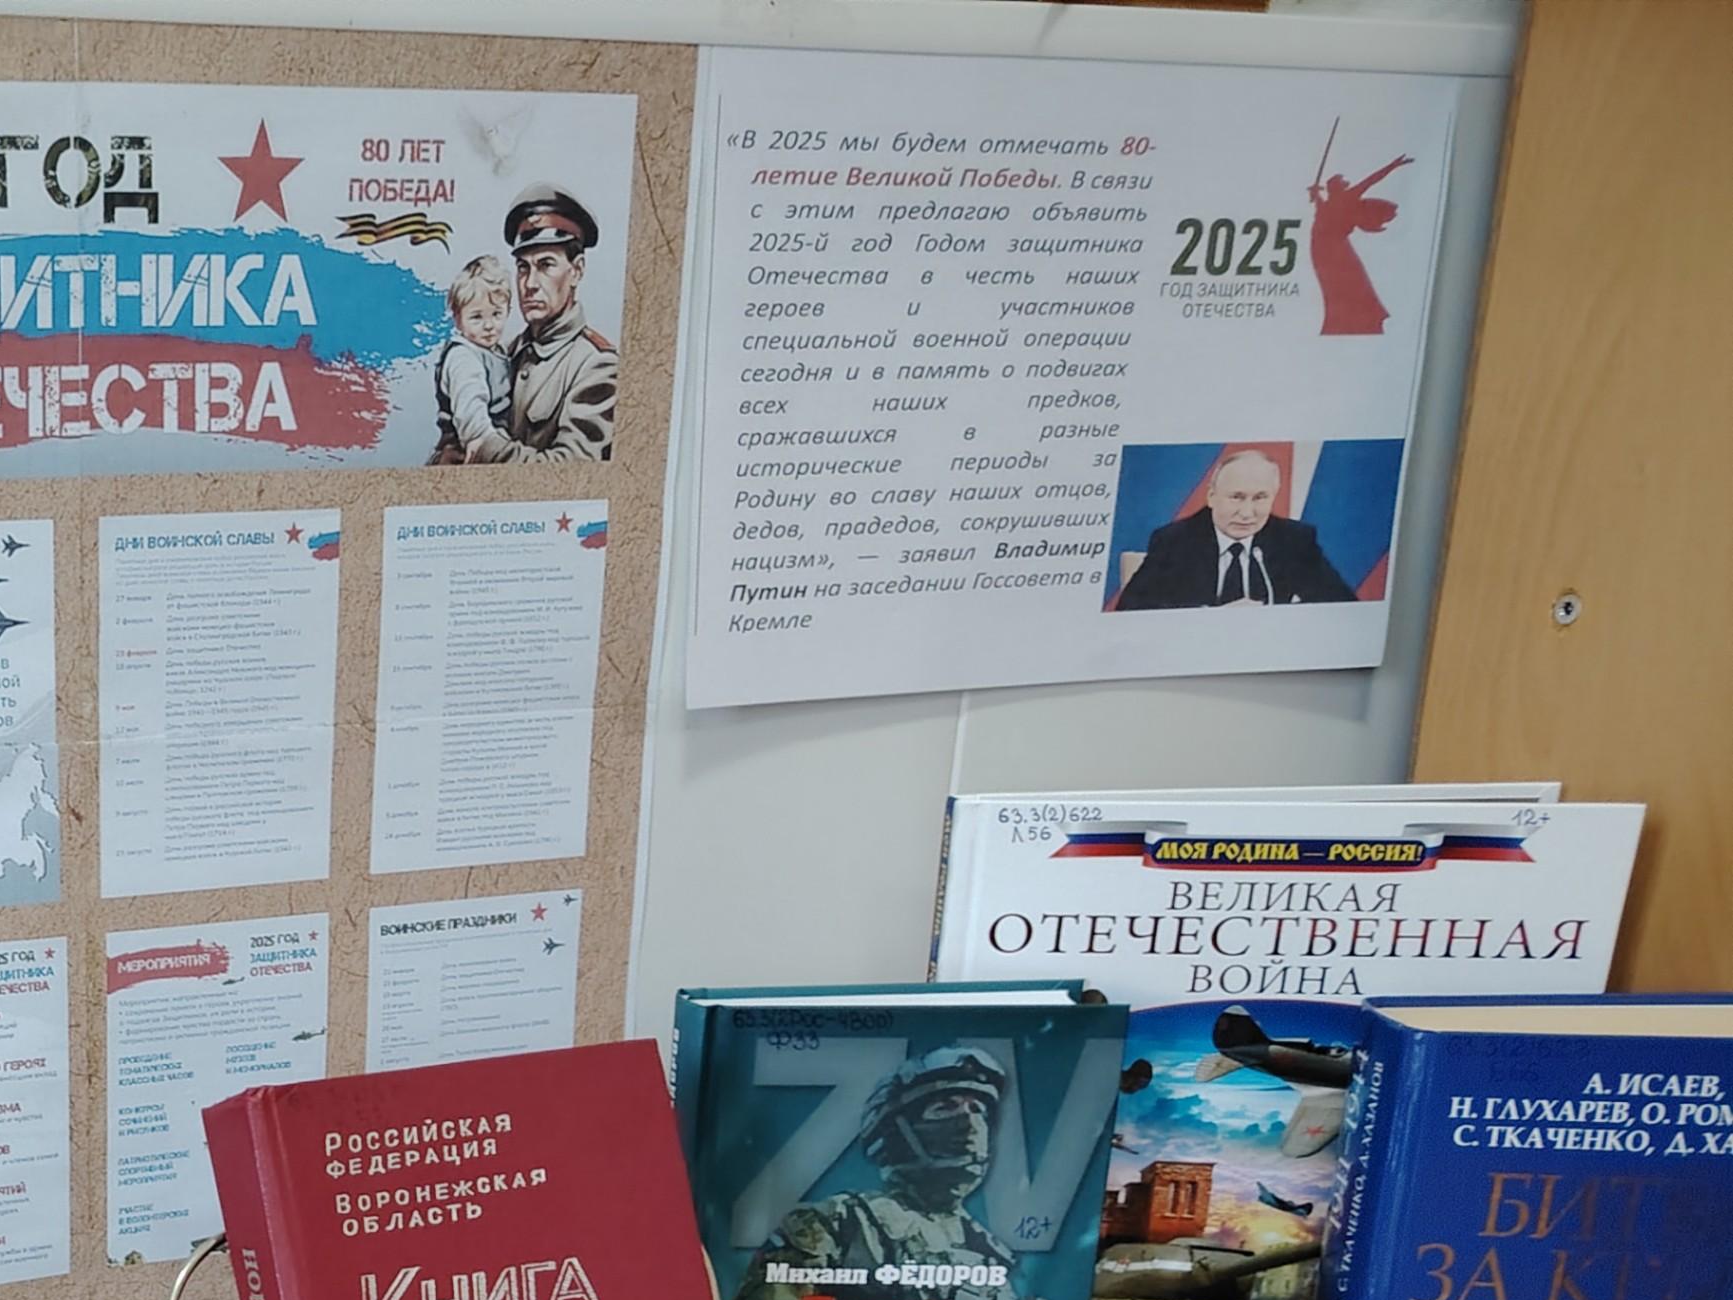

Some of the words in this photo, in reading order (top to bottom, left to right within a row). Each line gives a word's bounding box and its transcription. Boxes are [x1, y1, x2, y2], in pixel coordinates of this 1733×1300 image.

[359, 138, 391, 164] 80
[398, 136, 447, 164] ЛЕТ
[727, 130, 755, 150] «В
[768, 131, 827, 150] 2025
[840, 136, 878, 151] мы
[892, 133, 966, 152] будем
[979, 137, 1108, 156] отмечать
[1121, 137, 1156, 156] 80-
[346, 177, 457, 206] ПОБЕДА!
[751, 170, 837, 186] летие
[847, 167, 952, 188] Великой
[959, 167, 1062, 189] Победы.
[1070, 171, 1085, 189] В
[1090, 175, 1152, 190] связи
[750, 204, 762, 219] с
[785, 204, 854, 219] этим
[878, 203, 1009, 224] предлагаю
[1032, 202, 1147, 221] объявить
[749, 233, 828, 252] 2025-й
[851, 236, 892, 254] год
[916, 234, 985, 254] Годом
[1008, 238, 1143, 256] защитника
[1169, 218, 1301, 277] 2025
[748, 267, 888, 285] Отечества
[921, 270, 933, 285] в
[965, 270, 1035, 285] честь
[1067, 270, 1139, 285] наших
[1159, 283, 1193, 300] ГОД
[1197, 281, 1300, 299] ЗАЩИТНИКА
[1182, 302, 1276, 320] ОТЕЧЕСТВА
[115, 535, 143, 552] ДНИ
[147, 532, 223, 550] ВОИНСКОЙ
[226, 531, 275, 547] СЛАВЫ
[397, 525, 423, 541] ДНИ
[426, 521, 498, 538] ВОИНСКОЙ
[501, 521, 546, 535] СЛАВЫ
[1154, 839, 1208, 862] МОЯ
[1211, 839, 1301, 862] РОДИНА
[1327, 837, 1423, 862] РОССИЯ!
[1165, 879, 1404, 914] ВЕЛИКАЯ
[380, 919, 445, 936] ВОИНСКИЕ
[448, 913, 517, 930] ПРАЗДНИКИ
[985, 913, 1590, 962] ОТЕЧЕСТВЕННАЯ
[117, 952, 211, 974] МЕРОПРИЯТИЯ
[1184, 962, 1364, 997] ВОЙНА
[1583, 1072, 1611, 1095] А.
[1618, 1074, 1725, 1101] ИСАЕВ,
[1448, 1096, 1478, 1119] Н.
[1483, 1099, 1636, 1127] ГЛУХАРЕВ,
[1640, 1103, 1670, 1124] О.
[1452, 1125, 1480, 1147] С.
[1486, 1126, 1655, 1156] ТКАЧЕНКО,
[1664, 1133, 1694, 1156] Д.
[325, 1137, 499, 1179] ФЕДЕРАЦИЯ
[341, 1201, 484, 1237] ОБЛАСТЬ
[765, 1262, 868, 1286] Михаил
[874, 1258, 1008, 1288] ФЁДОРОВ
